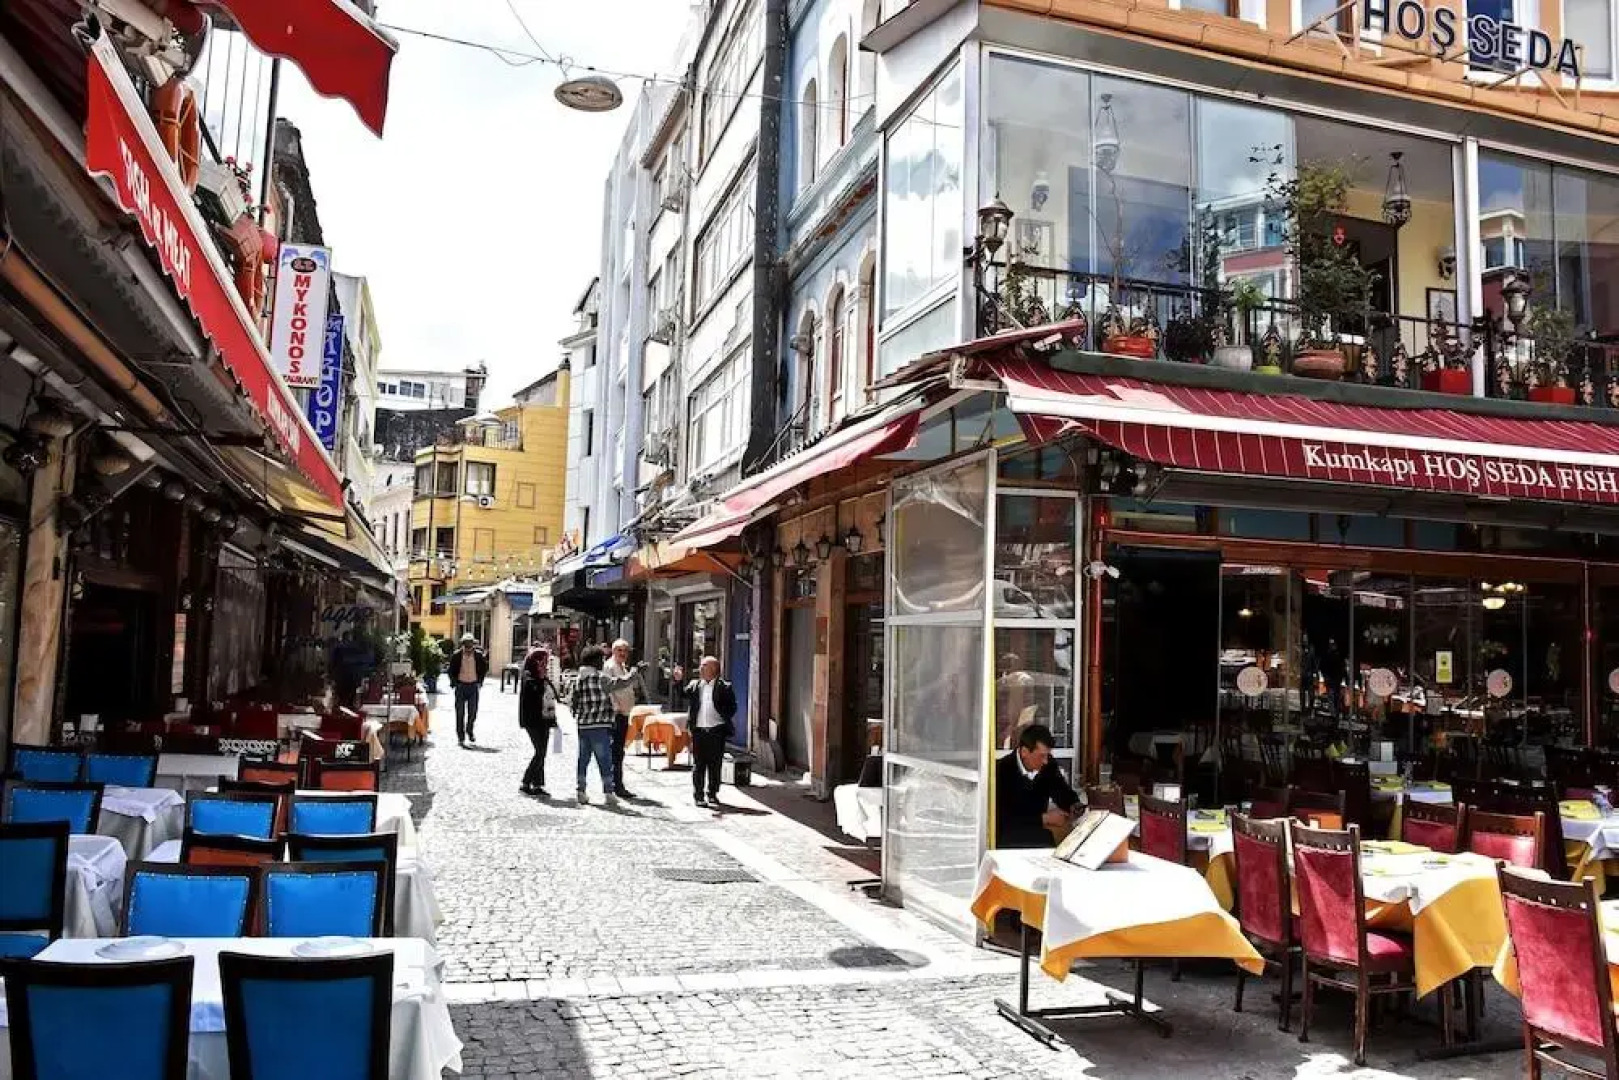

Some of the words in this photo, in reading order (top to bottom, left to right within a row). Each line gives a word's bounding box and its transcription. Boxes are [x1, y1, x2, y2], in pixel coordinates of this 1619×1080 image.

[1364, 0, 1456, 55] HOŞ
[1471, 15, 1580, 77] SEDA
[119, 138, 152, 226] FISH
[163, 209, 191, 290] MEAT
[289, 274, 312, 373] MYKONOS
[281, 375, 318, 385] TAURANT
[1302, 444, 1417, 480] Kumkapı
[1422, 455, 1481, 486] HOŞ
[1487, 461, 1555, 488] SEDA
[1560, 469, 1619, 493] FISH
